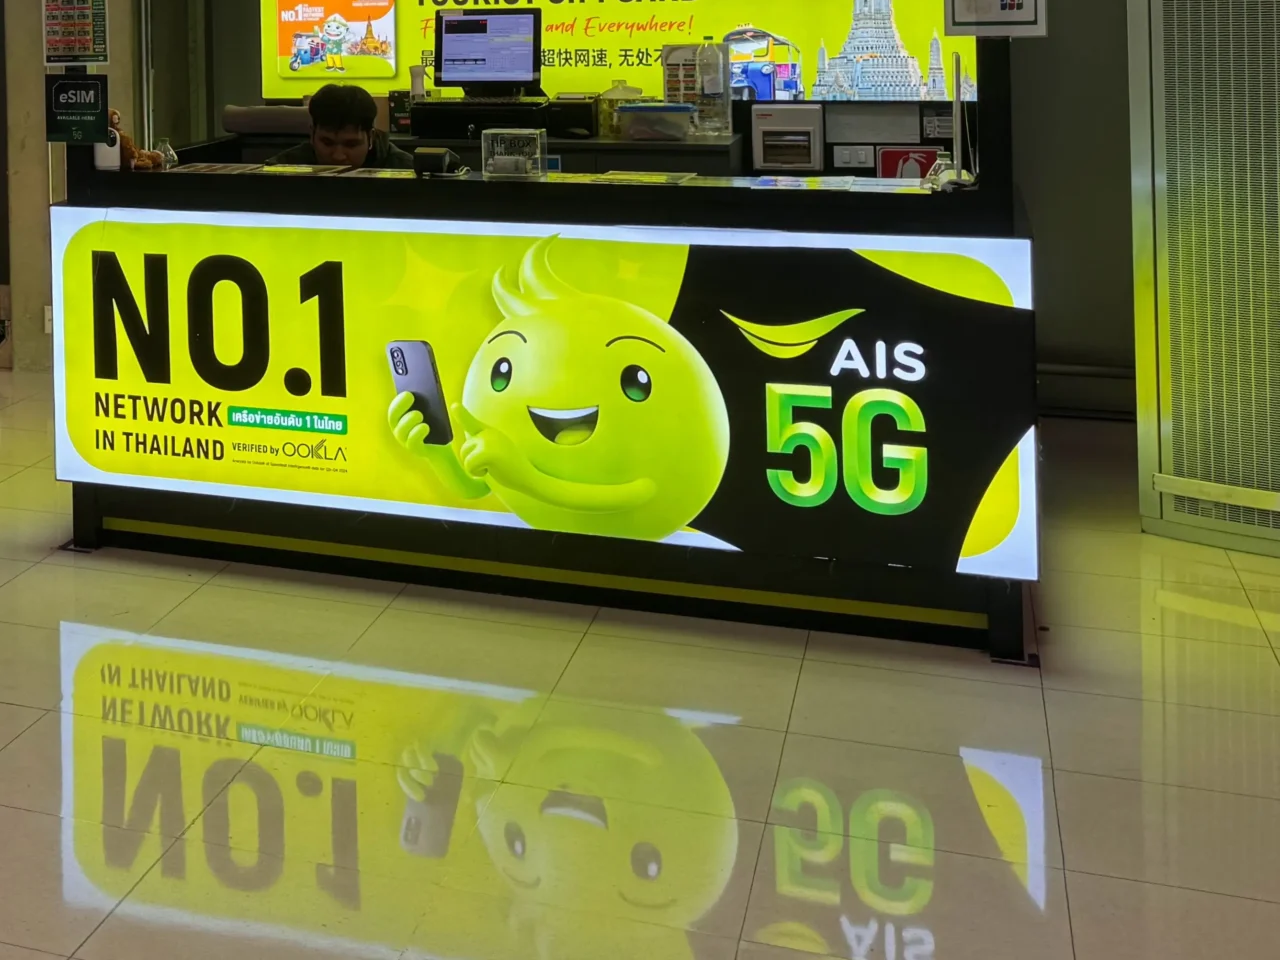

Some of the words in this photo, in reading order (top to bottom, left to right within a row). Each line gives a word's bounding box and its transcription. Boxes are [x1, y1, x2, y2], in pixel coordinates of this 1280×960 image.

[281, 3, 303, 21] NO.1
[545, 17, 575, 36] and
[583, 14, 694, 38] Everywhere!
[59, 90, 95, 103] eSIM
[490, 139, 506, 148] TIP
[510, 139, 532, 148] BOX
[91, 249, 348, 399] NO.1
[829, 338, 926, 382] AIS
[94, 391, 224, 428] NETWORK
[95, 428, 115, 451] IN
[122, 431, 225, 462] THAILAND
[232, 441, 268, 454] VERIFIED
[269, 445, 280, 457] by
[282, 438, 348, 462] OOKLA
[765, 382, 929, 516] 5G
